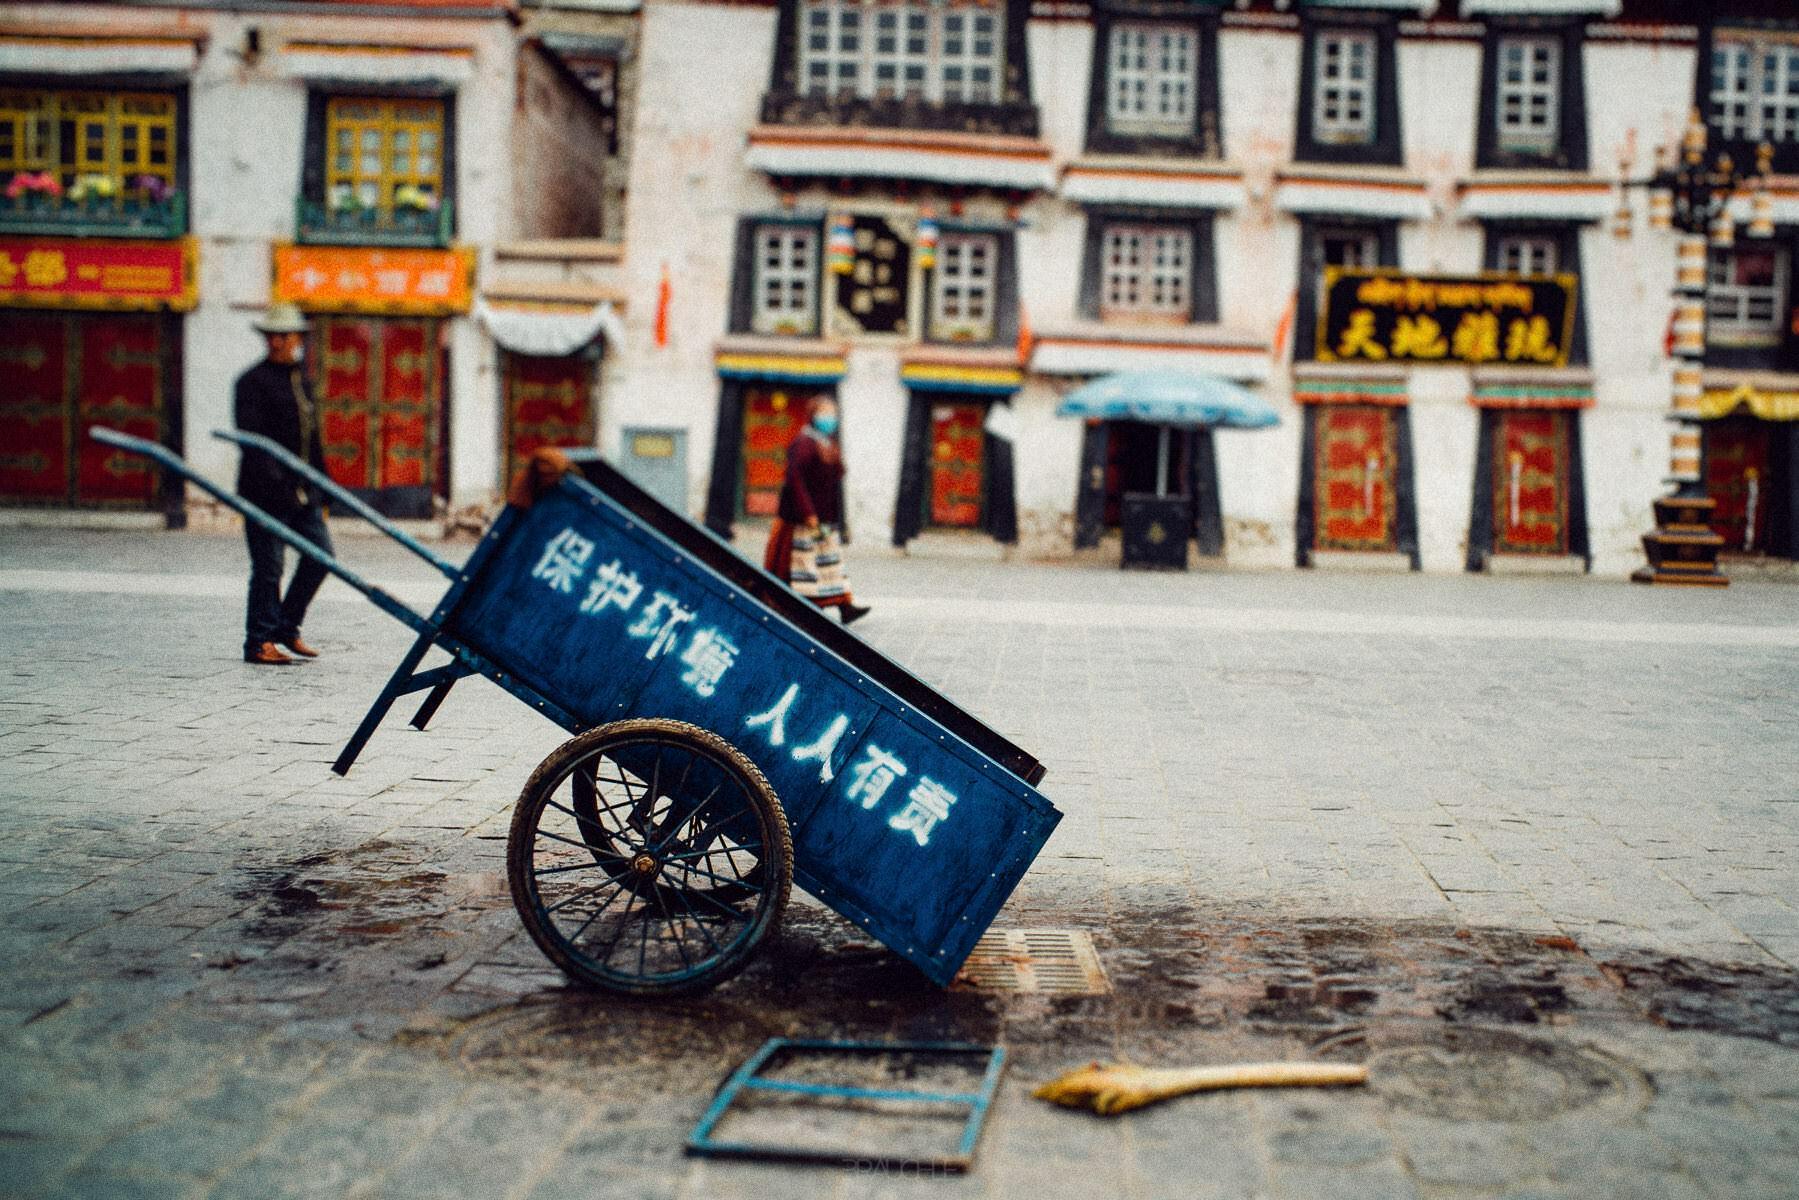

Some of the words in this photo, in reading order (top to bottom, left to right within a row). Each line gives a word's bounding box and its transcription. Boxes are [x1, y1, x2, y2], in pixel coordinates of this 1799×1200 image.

[531, 527, 740, 697] 保护环境
[745, 683, 958, 847] 人人有责
